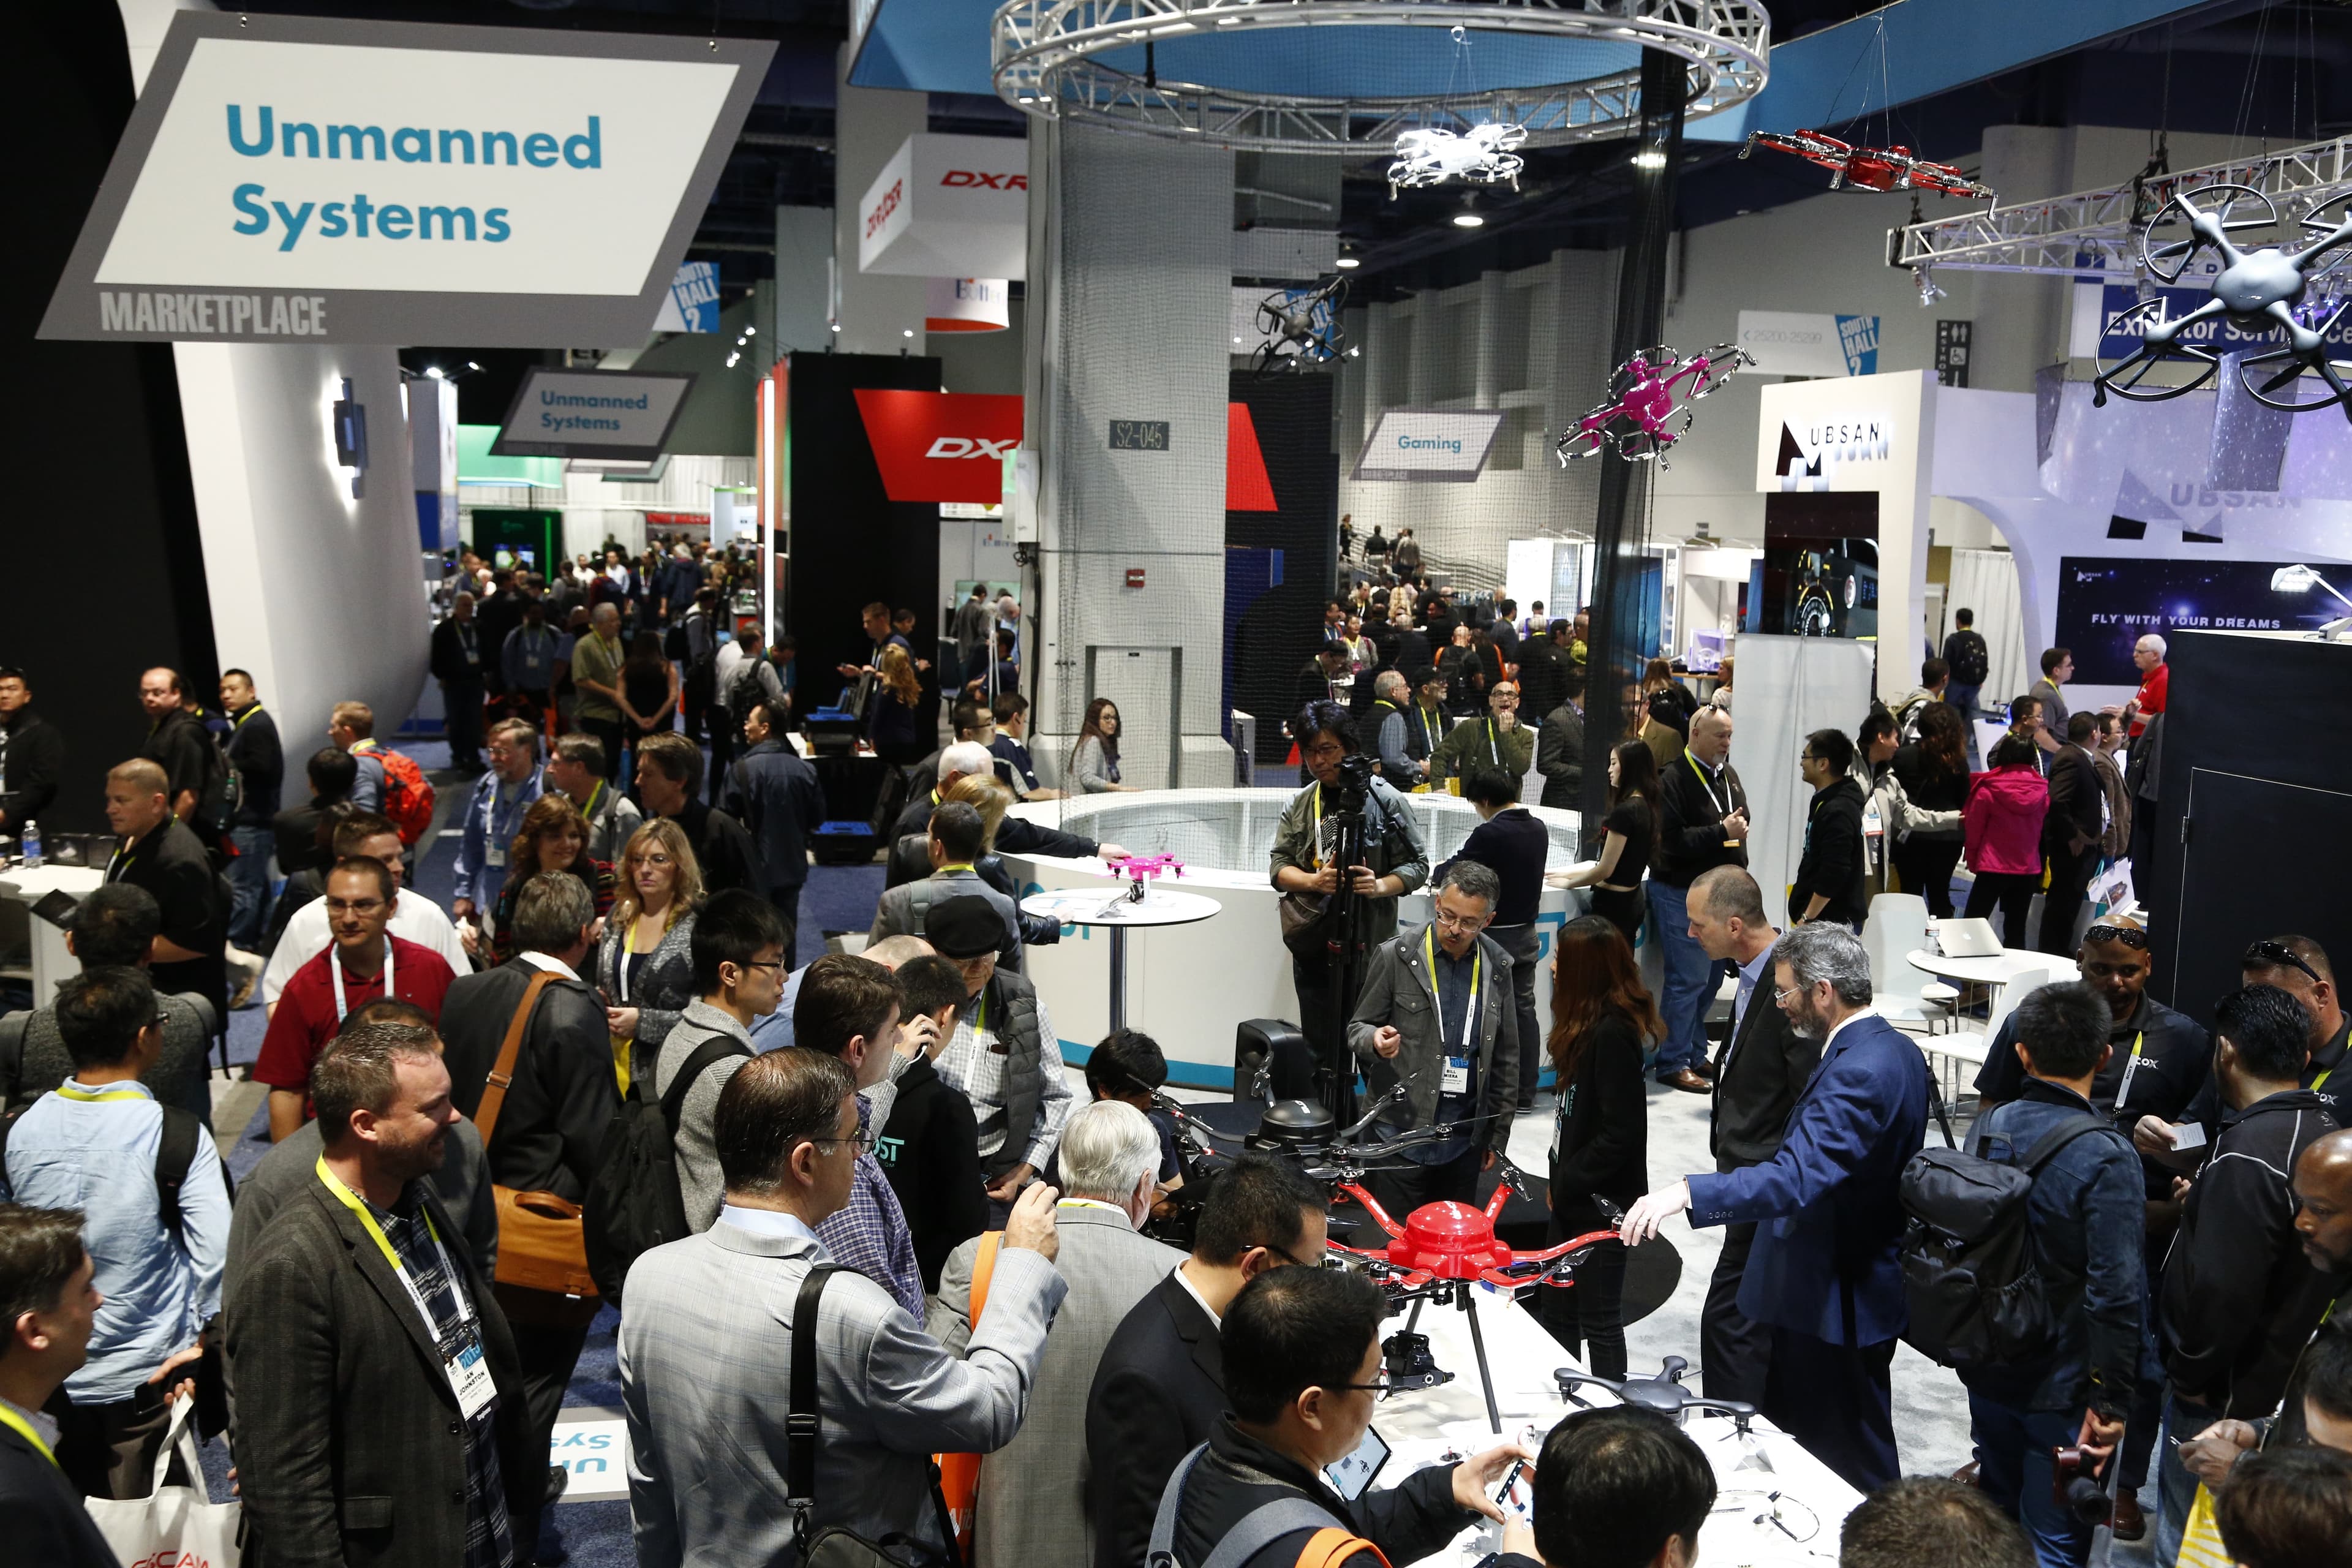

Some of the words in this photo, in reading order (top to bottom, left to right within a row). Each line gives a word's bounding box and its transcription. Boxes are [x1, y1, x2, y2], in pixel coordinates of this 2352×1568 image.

[227, 104, 602, 170] Unmanned
[232, 183, 511, 252] Systems
[676, 276, 720, 309] HALL
[99, 292, 328, 336] MARKETPLACE
[685, 307, 707, 333] 2
[1839, 316, 1874, 337] SOUTH
[1844, 330, 1879, 358] HALL
[1849, 356, 1862, 375] 2
[541, 390, 648, 410] Unmanned
[541, 413, 620, 432] Systems
[1117, 422, 1163, 449] S2-045
[1398, 435, 1461, 453] Gaming
[2091, 614, 2118, 624] FLY
[2124, 615, 2161, 625] WITH
[2168, 616, 2209, 627] YOUR
[2215, 617, 2280, 629] DREAMS
[2136, 1057, 2160, 1069] COX
[459, 1370, 486, 1396] JOHNSTON
[464, 1370, 475, 1381] IAN
